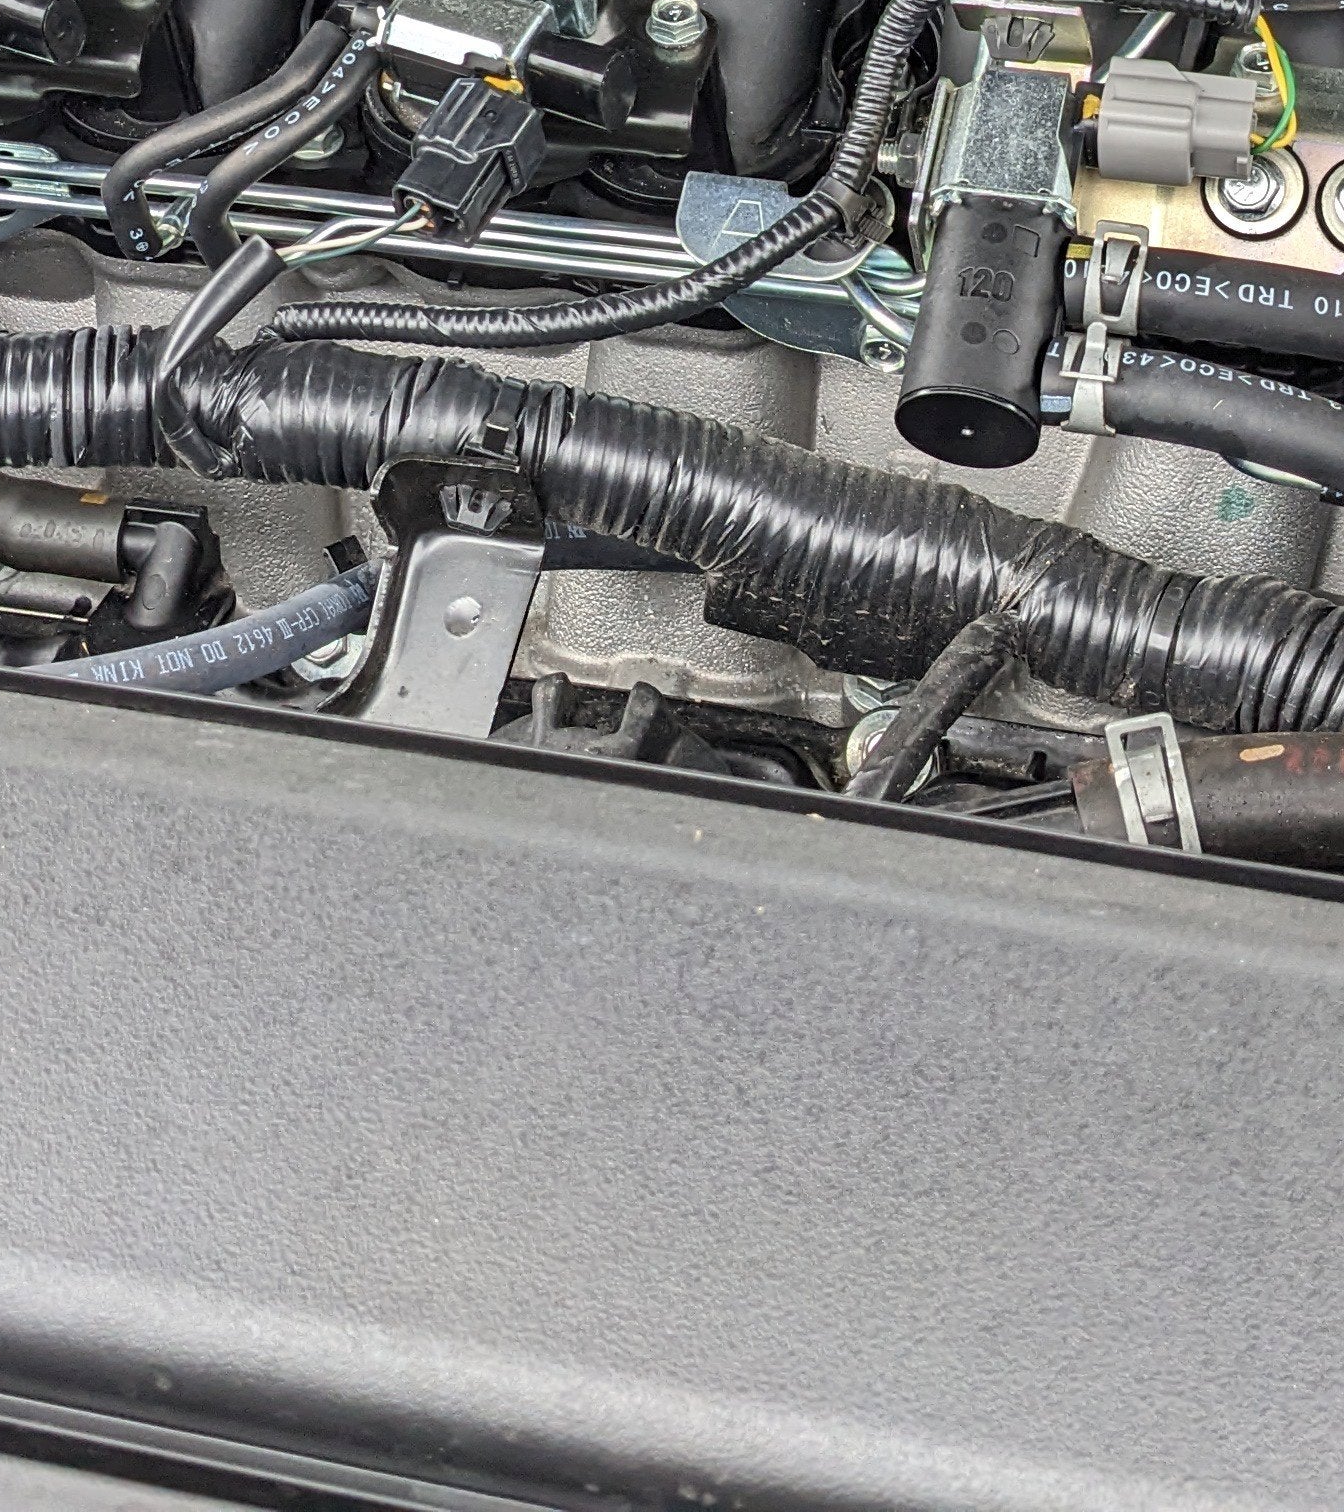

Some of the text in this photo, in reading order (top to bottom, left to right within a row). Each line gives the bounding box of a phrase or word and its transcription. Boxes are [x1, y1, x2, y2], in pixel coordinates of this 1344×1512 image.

[957, 266, 1015, 302] 120
[157, 649, 194, 675] NOT
[200, 642, 229, 664] DO
